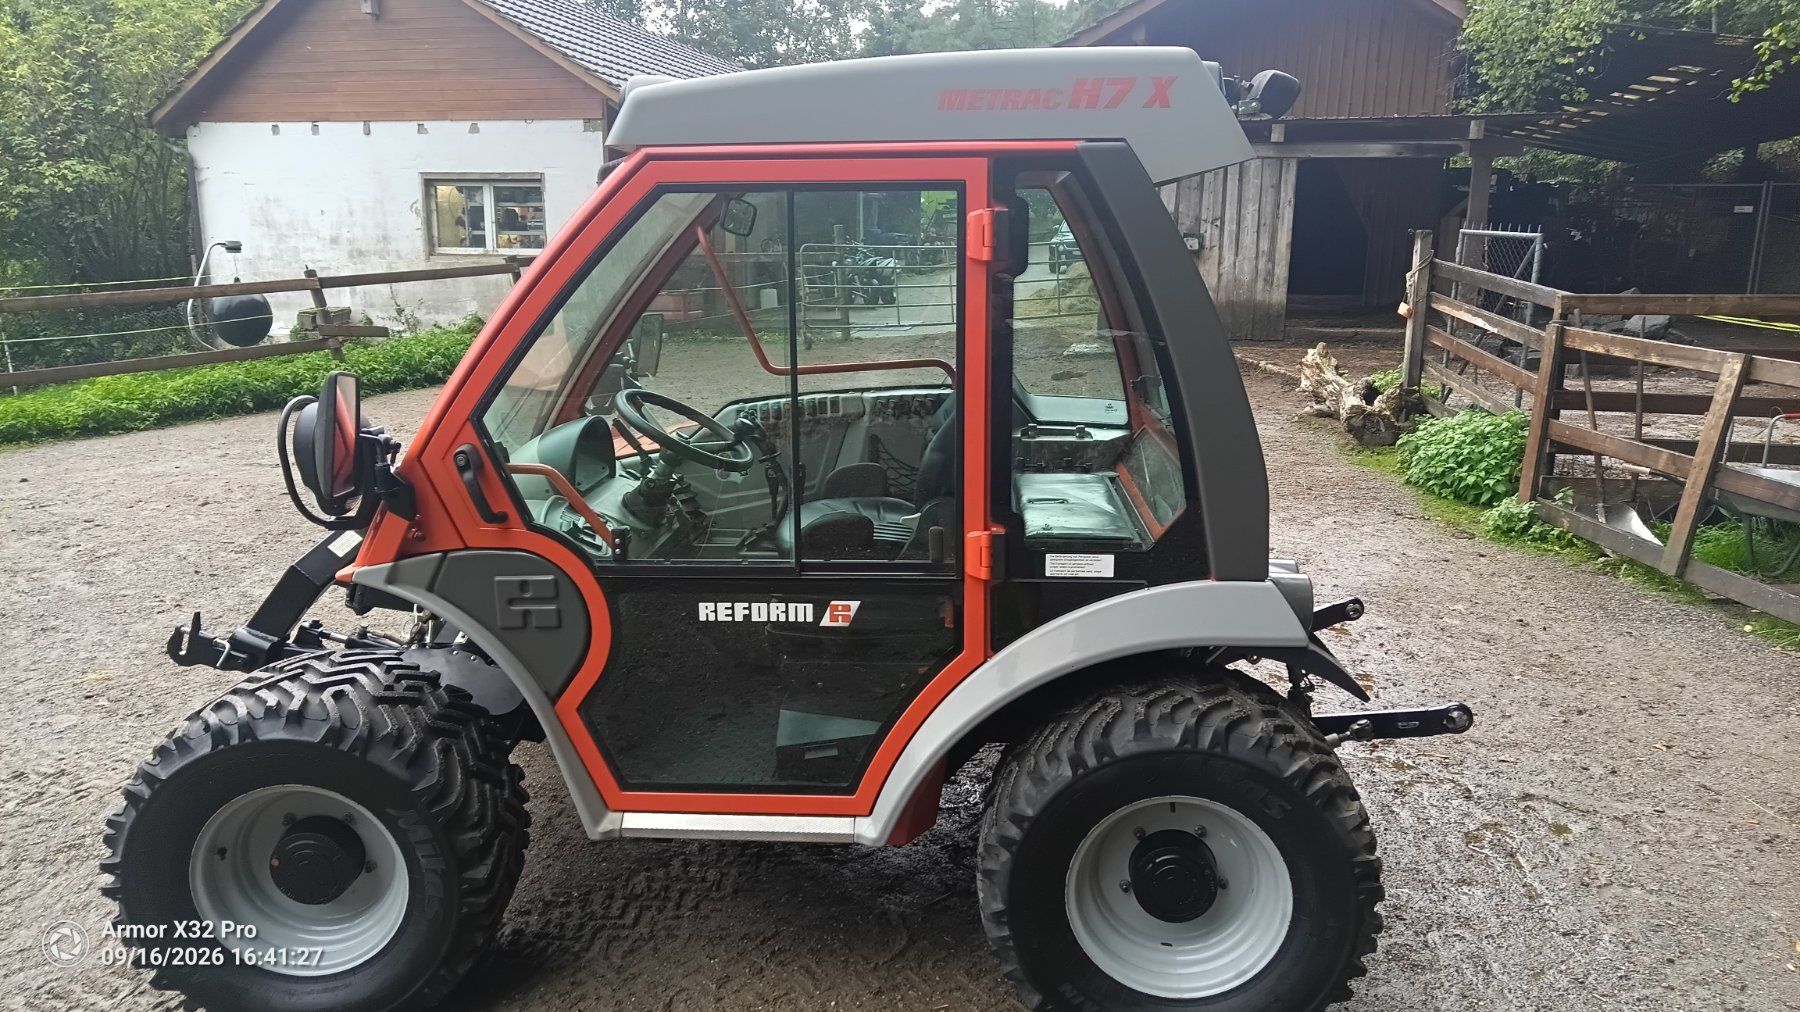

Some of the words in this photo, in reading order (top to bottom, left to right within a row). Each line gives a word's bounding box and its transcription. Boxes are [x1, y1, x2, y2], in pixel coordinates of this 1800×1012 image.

[937, 89, 1064, 110] METRAC
[1067, 77, 1137, 109] H7
[1142, 76, 1178, 108] X
[698, 602, 814, 622] REFORM
